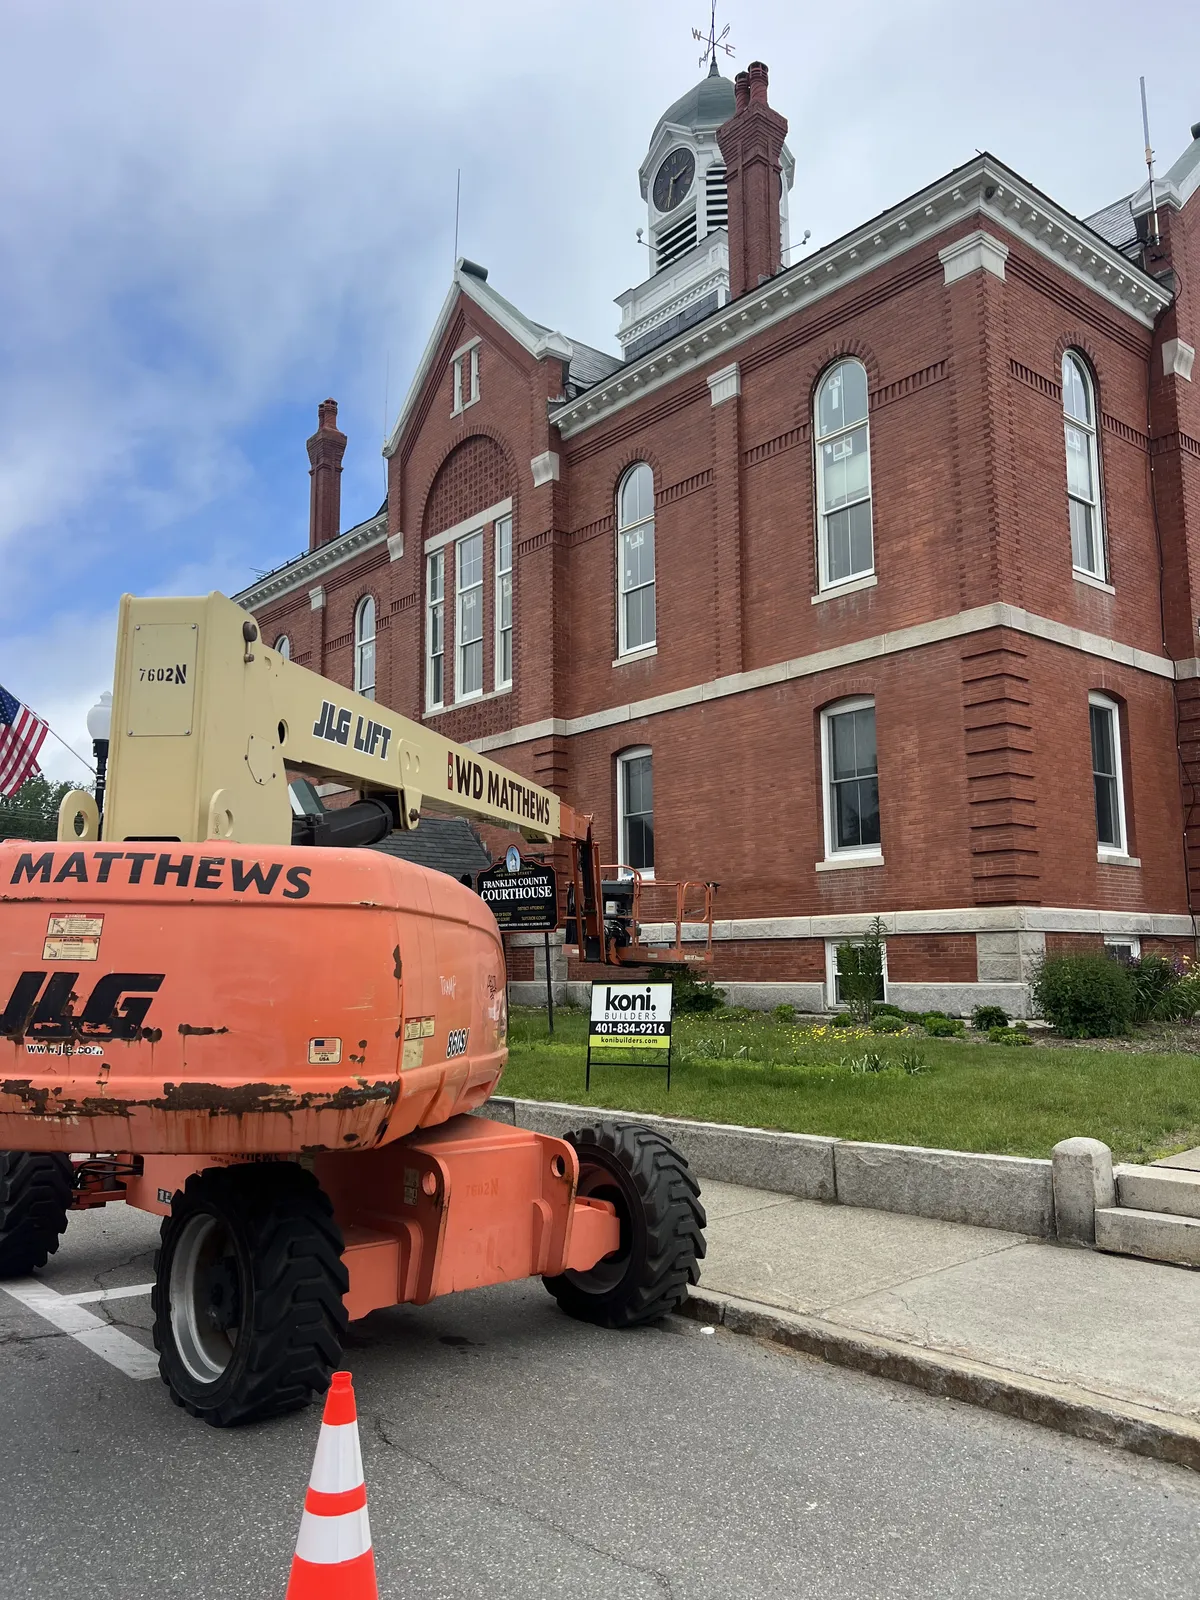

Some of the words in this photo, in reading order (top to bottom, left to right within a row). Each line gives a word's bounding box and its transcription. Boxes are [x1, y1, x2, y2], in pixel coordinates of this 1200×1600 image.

[139, 664, 187, 684] 7602N
[312, 699, 353, 747] JLG
[353, 714, 392, 761] LIFT
[455, 754, 484, 800] WD
[487, 769, 550, 826] MATTHEWS
[9, 851, 312, 899] MATTHEWS
[483, 879, 516, 888] FRANKLIN
[518, 876, 548, 886] COUNTY
[481, 886, 552, 901] COURTHOUSE
[605, 986, 657, 1012] koni.
[604, 1012, 657, 1020] BUILDERS
[595, 1023, 665, 1034] 401-834-9216
[600, 1036, 658, 1044] konibuilders.com
